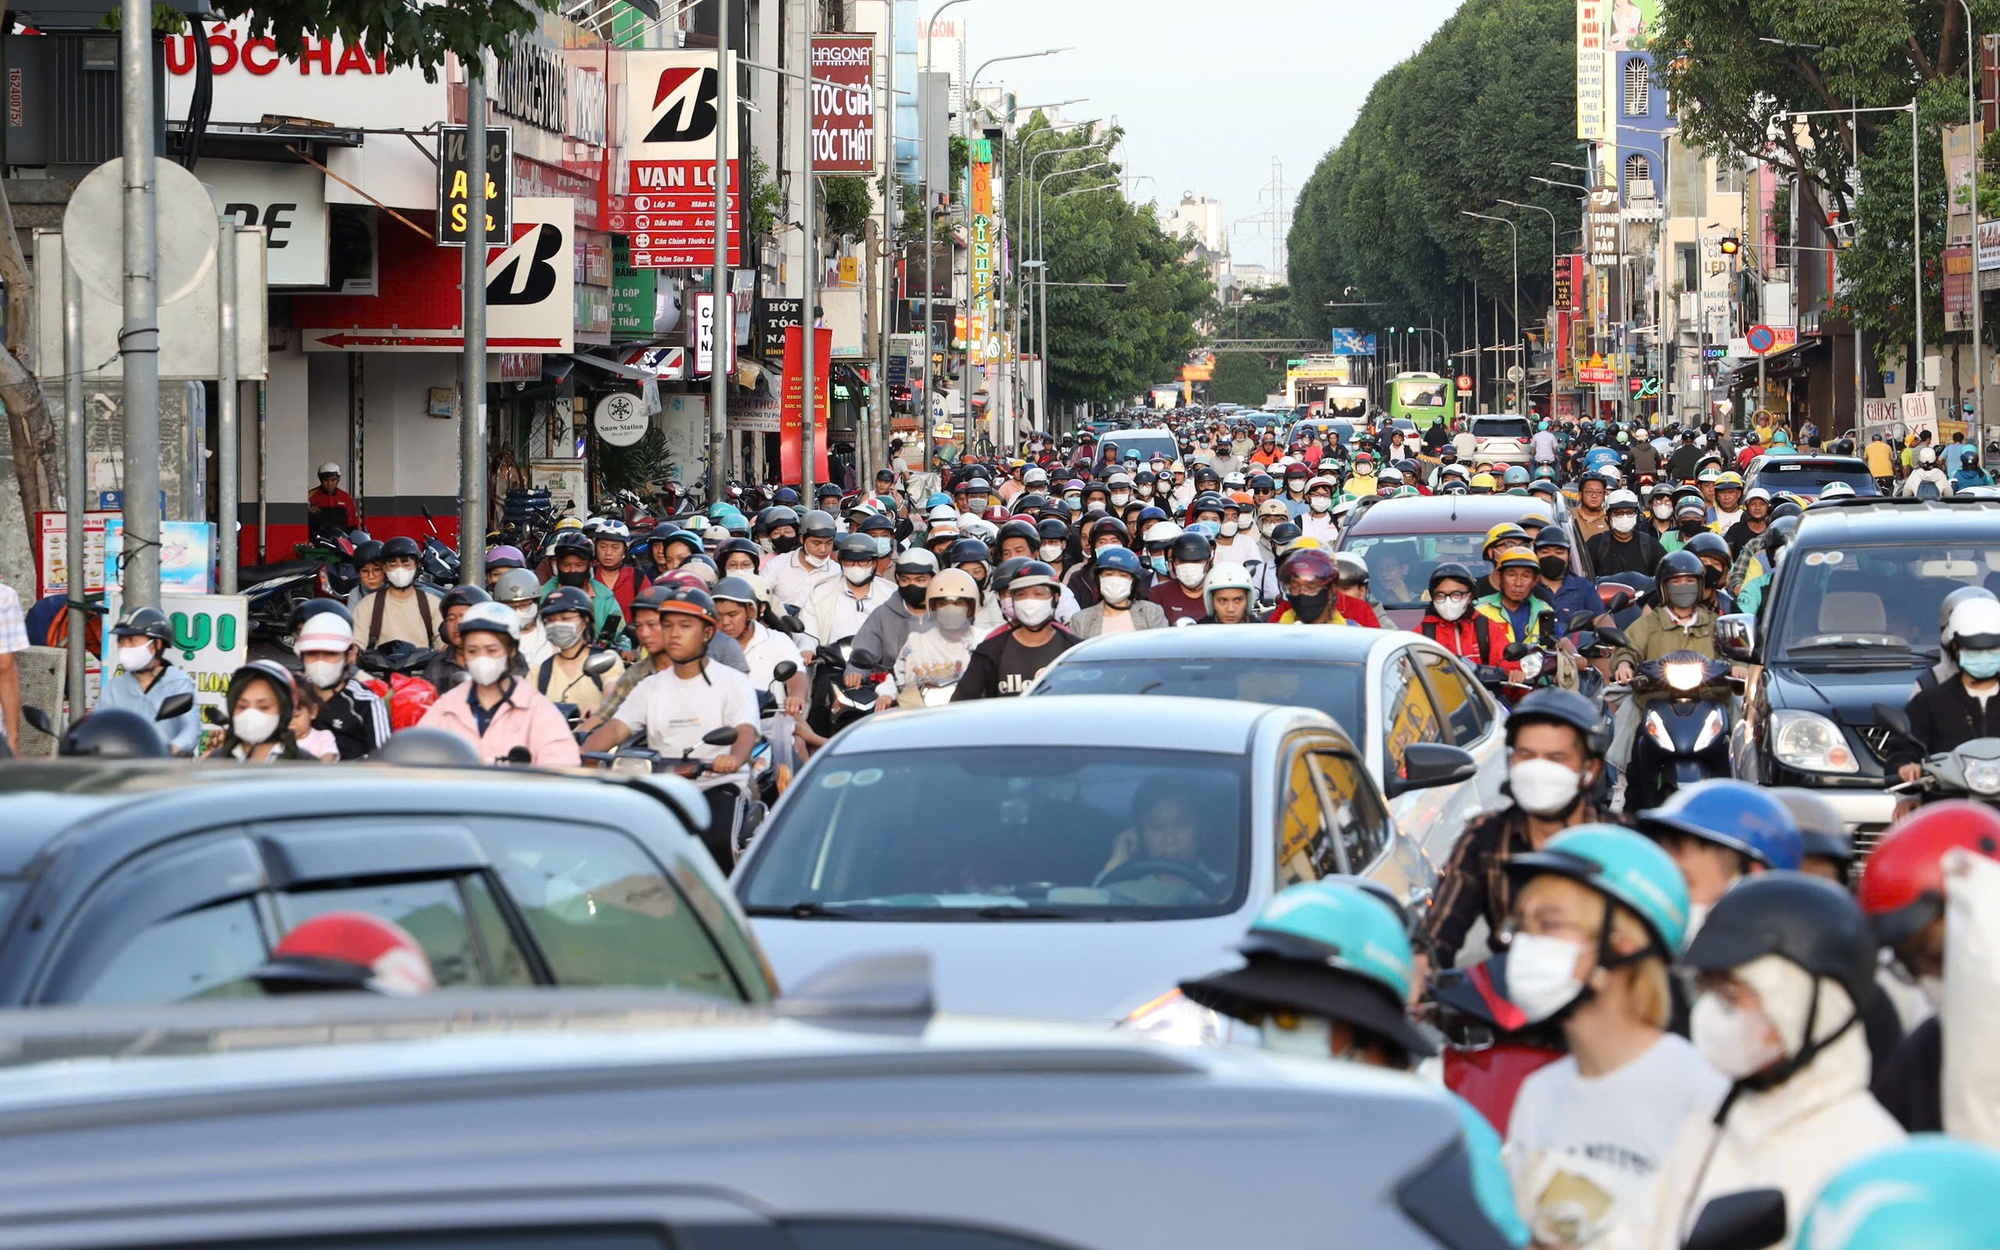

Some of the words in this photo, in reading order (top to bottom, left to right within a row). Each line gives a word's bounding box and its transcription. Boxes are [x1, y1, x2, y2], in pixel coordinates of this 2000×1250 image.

[811, 75, 842, 116] TÓC
[846, 75, 872, 116] GIẢ
[811, 120, 838, 161] TÓC
[840, 120, 872, 165] THẬT
[637, 167, 685, 190] VẠN
[1588, 213, 1620, 223] TRUNG
[1594, 225, 1615, 238] TÂM
[1595, 238, 1614, 251] BẢO
[1705, 261, 1726, 273] LED
[600, 424, 618, 432] Snow
[620, 422, 644, 430] Station
